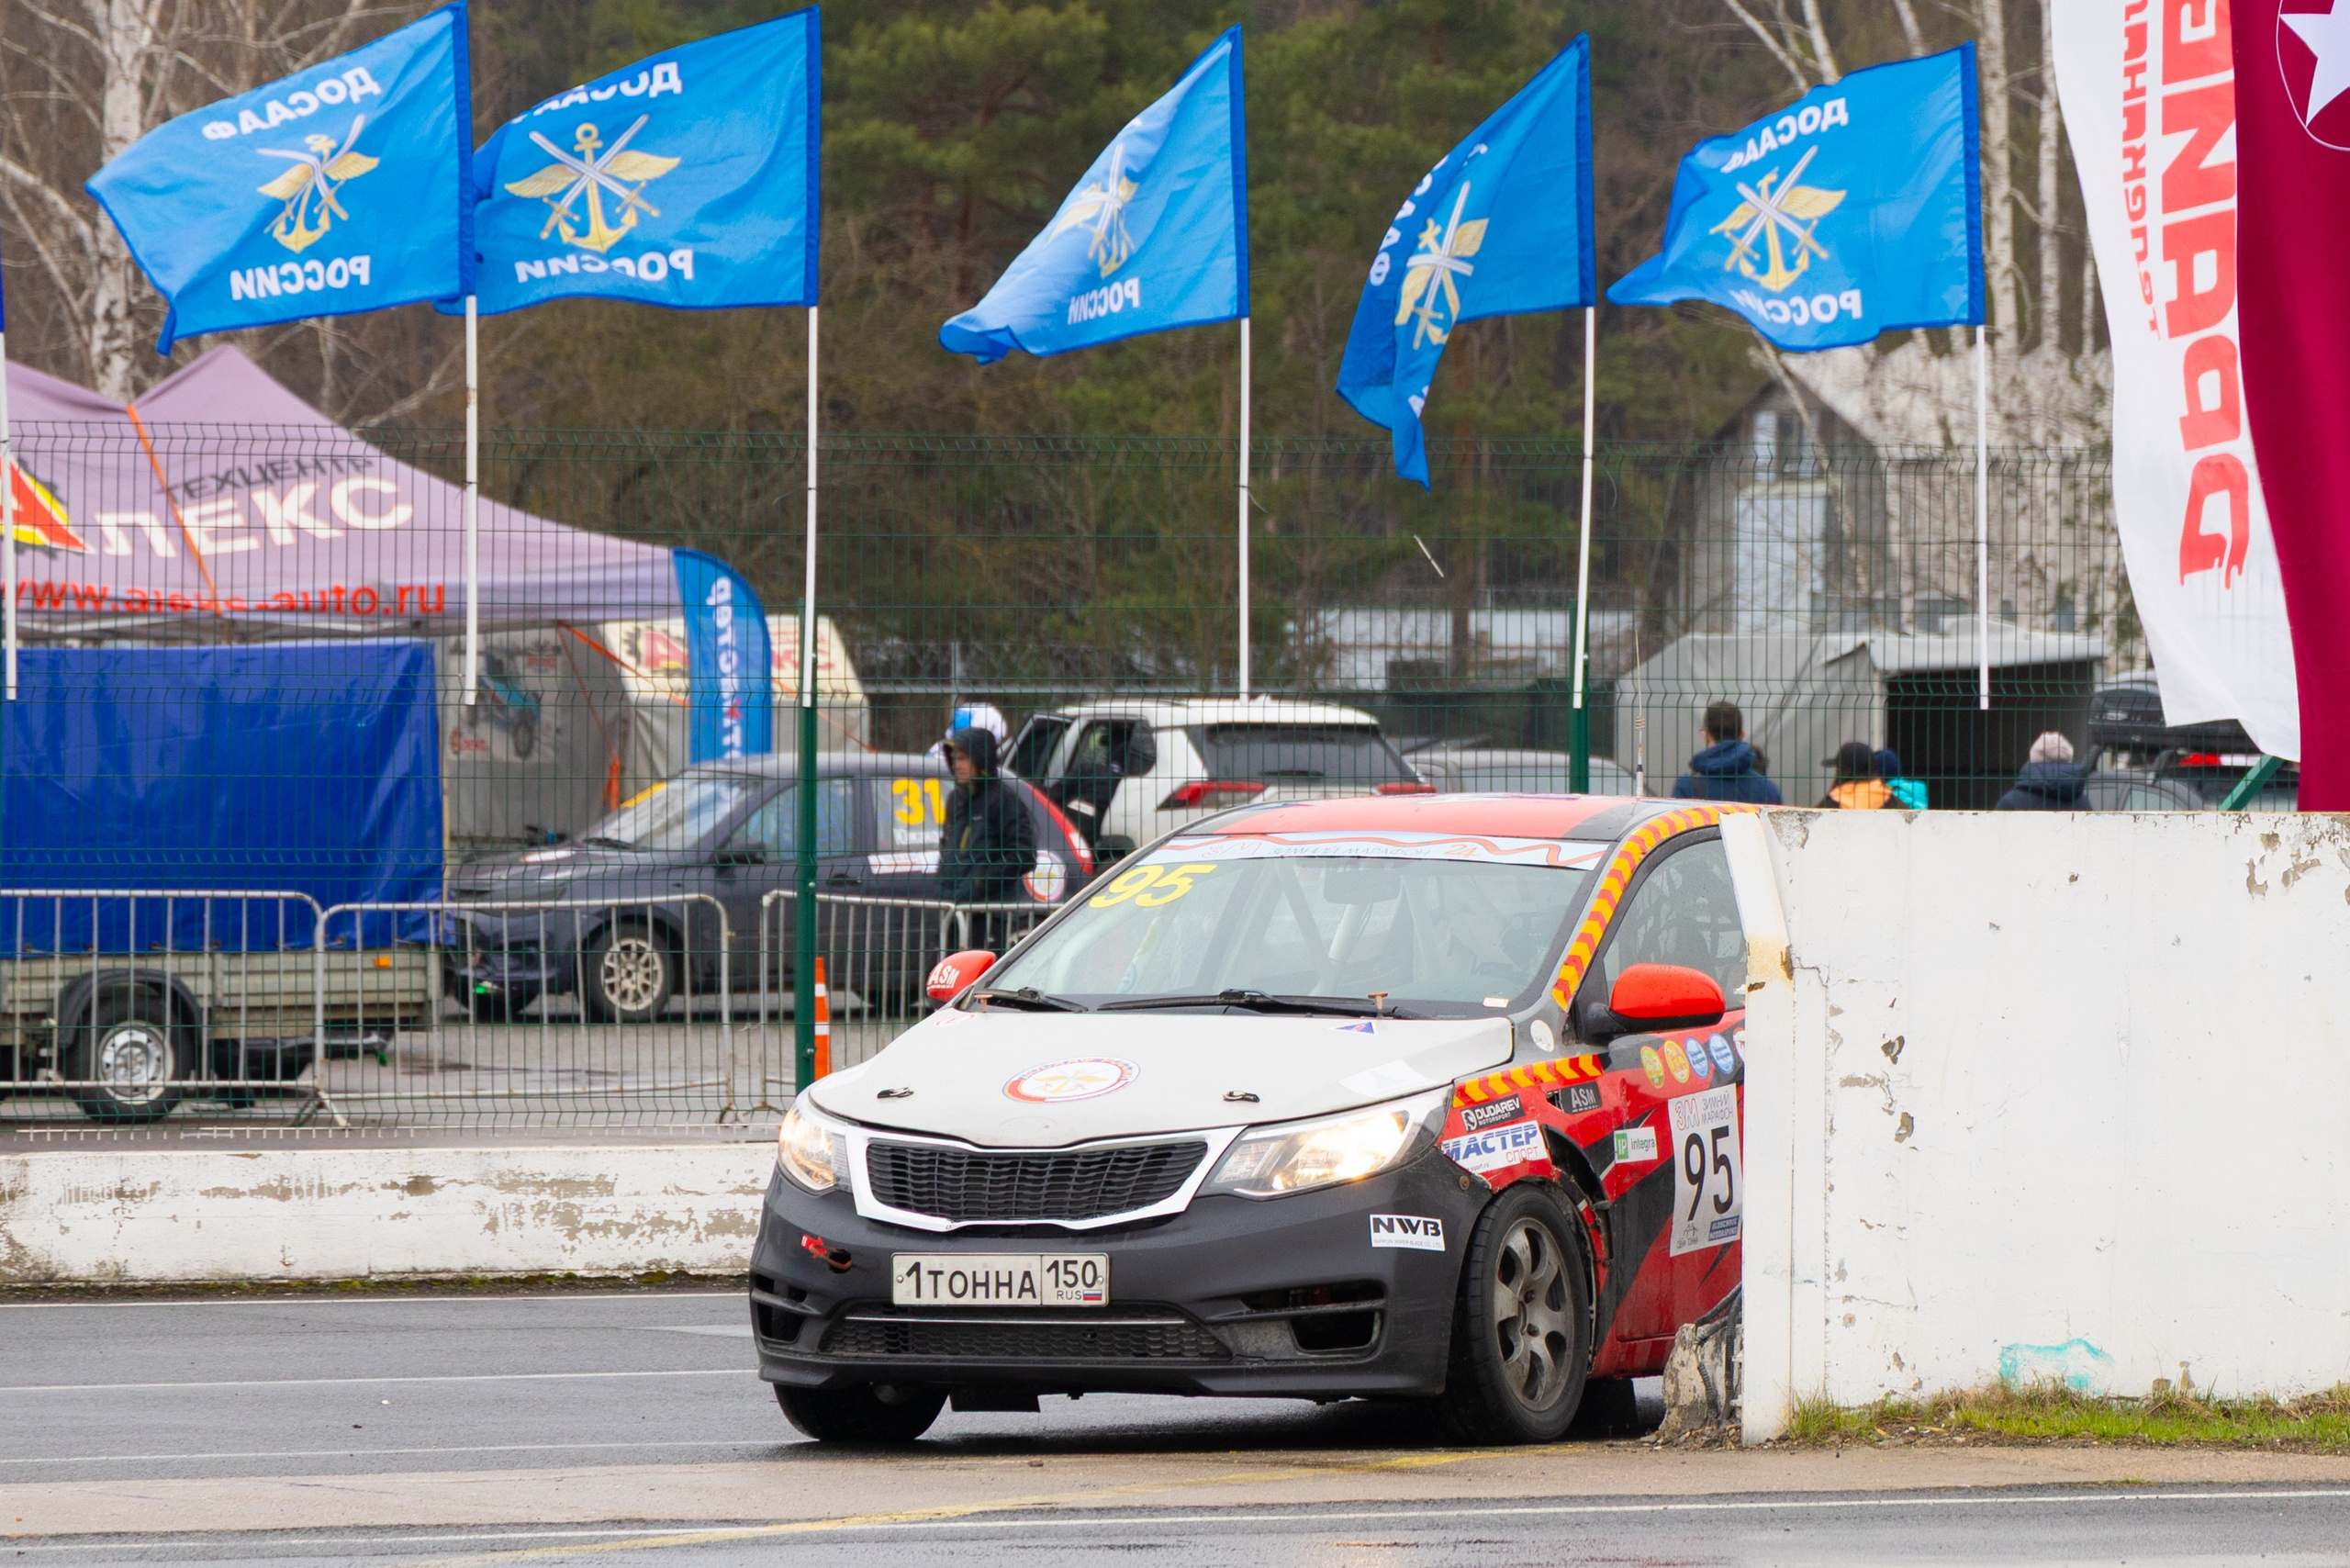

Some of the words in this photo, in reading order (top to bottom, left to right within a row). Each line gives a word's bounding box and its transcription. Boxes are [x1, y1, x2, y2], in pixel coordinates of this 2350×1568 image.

[891, 778, 946, 824] 31
[1089, 864, 1218, 909] 95
[927, 962, 960, 989] ASM
[1474, 1097, 1520, 1120] DUDAREV
[1571, 1087, 1597, 1109] ASM
[1442, 1124, 1538, 1162] МАСТЕР
[1505, 1146, 1539, 1163] СПОРТ
[1631, 1138, 1656, 1152] integra
[1684, 1125, 1734, 1222] 95
[1372, 1217, 1441, 1237] NWB
[905, 1261, 1037, 1299] 1ТОННА
[1046, 1260, 1098, 1288] 150
[1057, 1290, 1082, 1301] RUS
